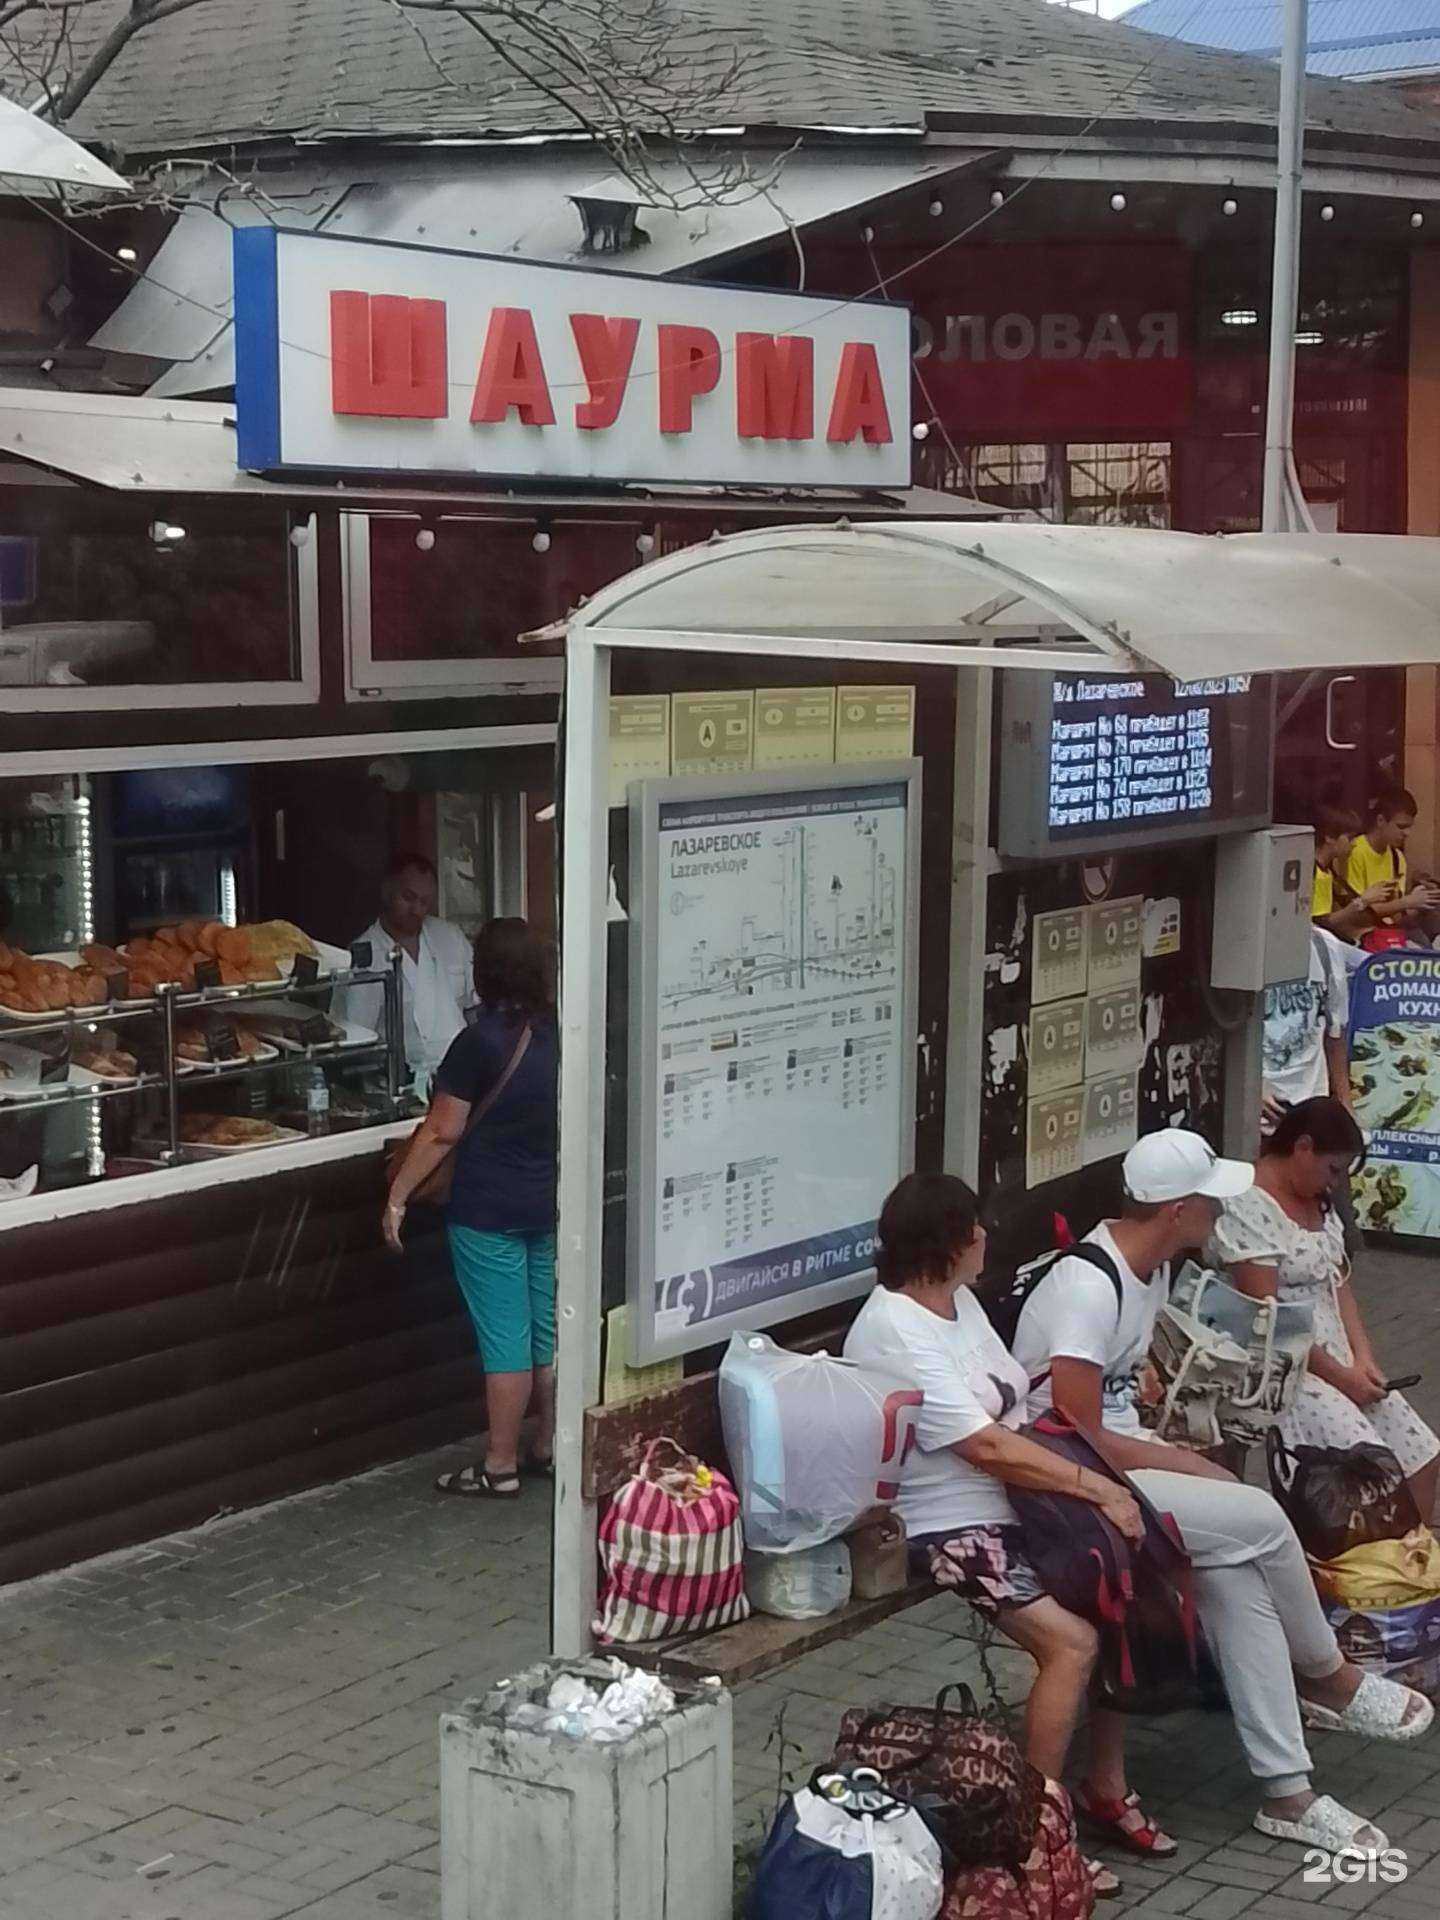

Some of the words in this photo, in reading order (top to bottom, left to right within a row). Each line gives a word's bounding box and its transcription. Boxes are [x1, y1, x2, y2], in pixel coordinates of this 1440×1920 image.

[329, 289, 893, 444] ШАУРМА
[670, 831, 762, 858] ЛАЗАРЕВСКОЕ
[671, 857, 748, 879] Lazarevskoye
[715, 1262, 789, 1302] ДВИГАЙСЯ
[792, 1259, 802, 1278] В
[805, 1245, 851, 1274] РИТМЕ
